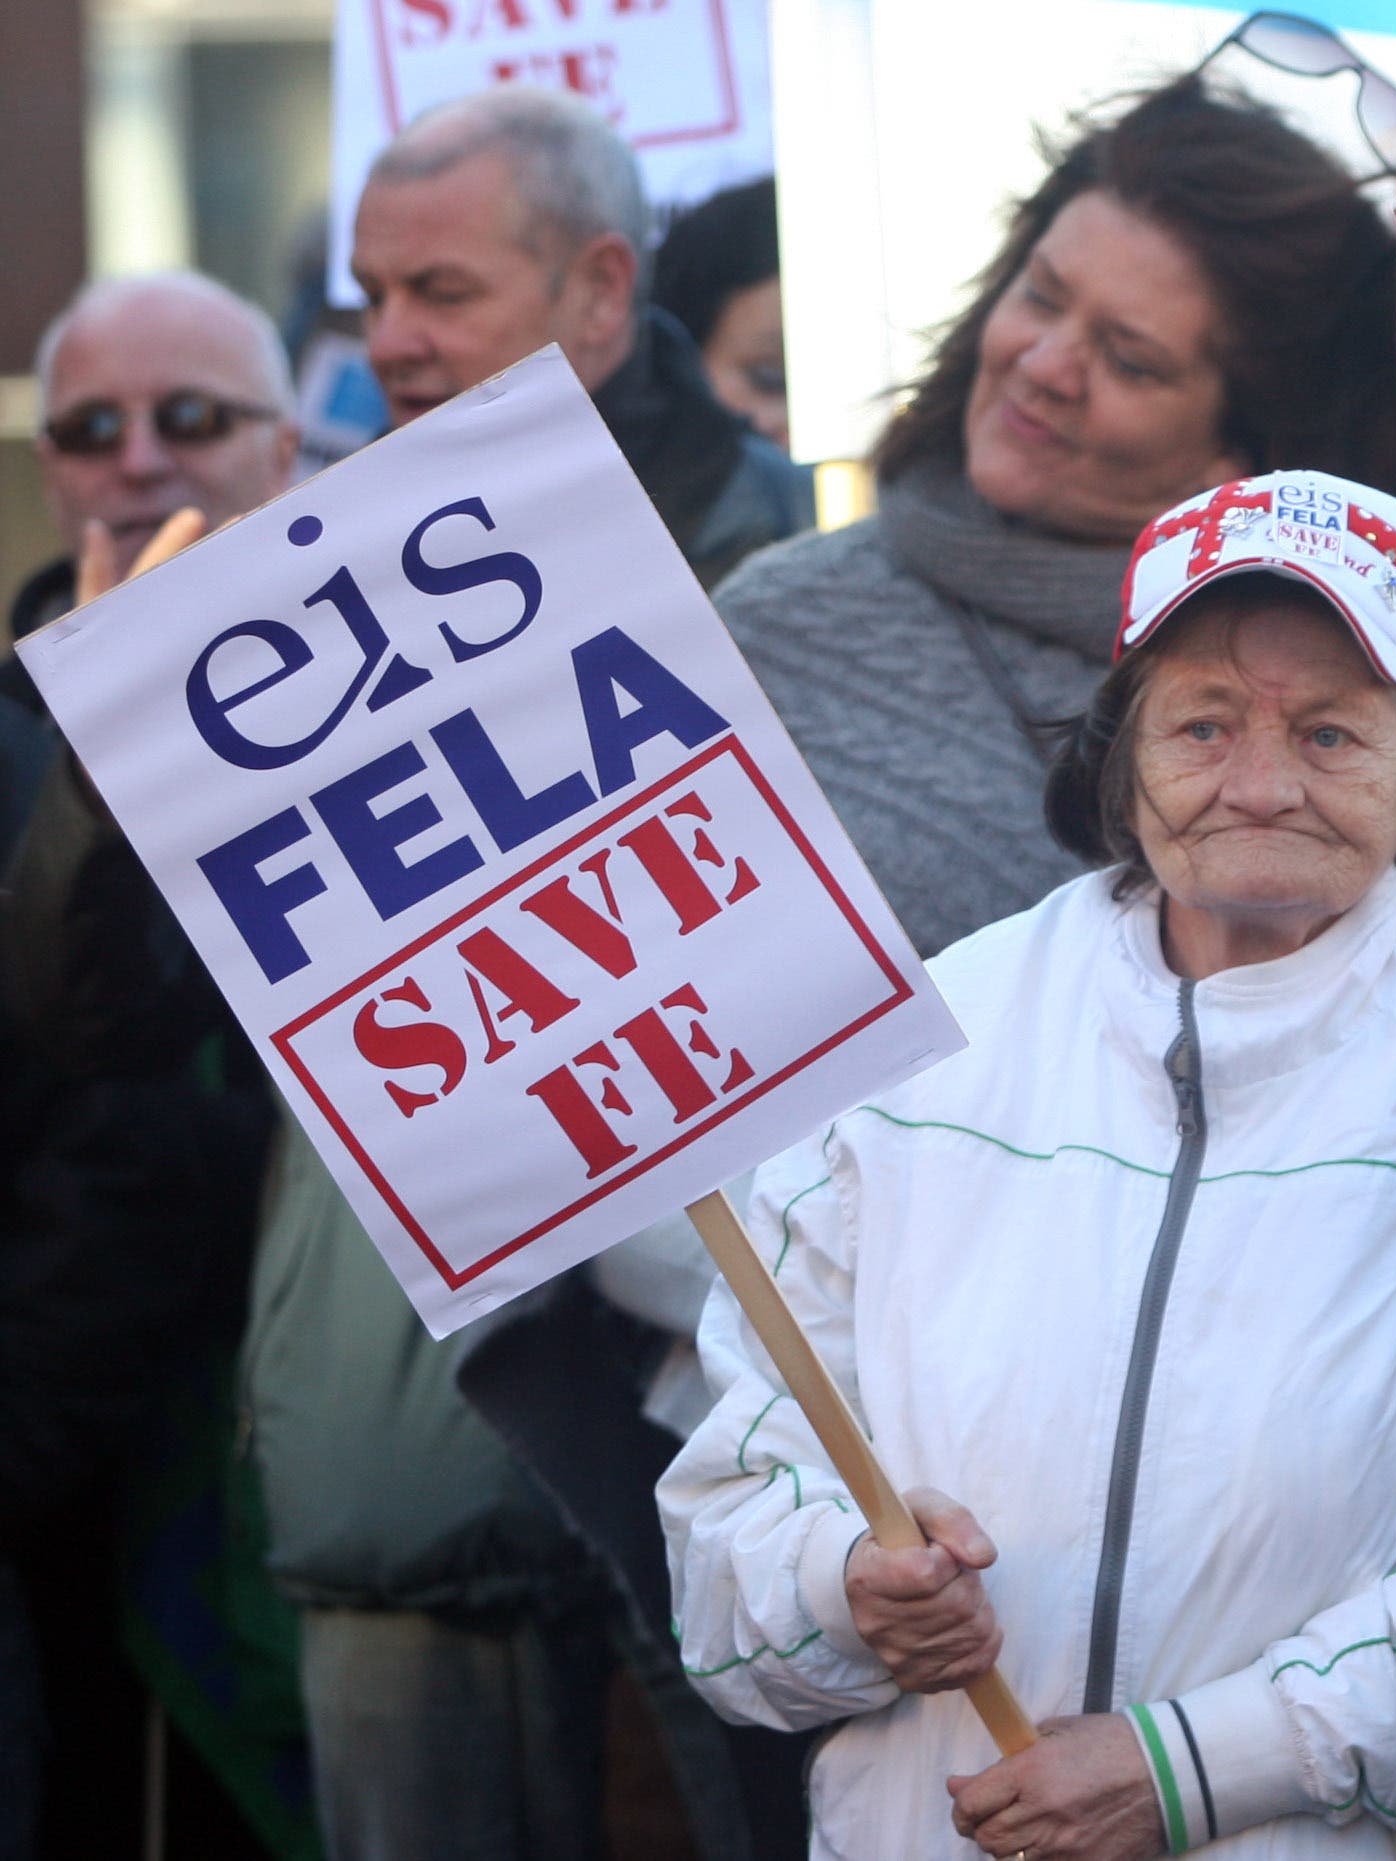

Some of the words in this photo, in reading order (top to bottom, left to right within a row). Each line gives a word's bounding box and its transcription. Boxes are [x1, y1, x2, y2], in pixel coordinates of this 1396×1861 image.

[402, 0, 668, 47] SA
[1277, 506, 1341, 531] FELA
[1278, 482, 1342, 512] eis
[1279, 525, 1338, 551] SAVE
[185, 496, 543, 770] eis
[195, 625, 732, 986] FELA
[352, 791, 761, 1118] SAVE
[526, 982, 755, 1180] FE
